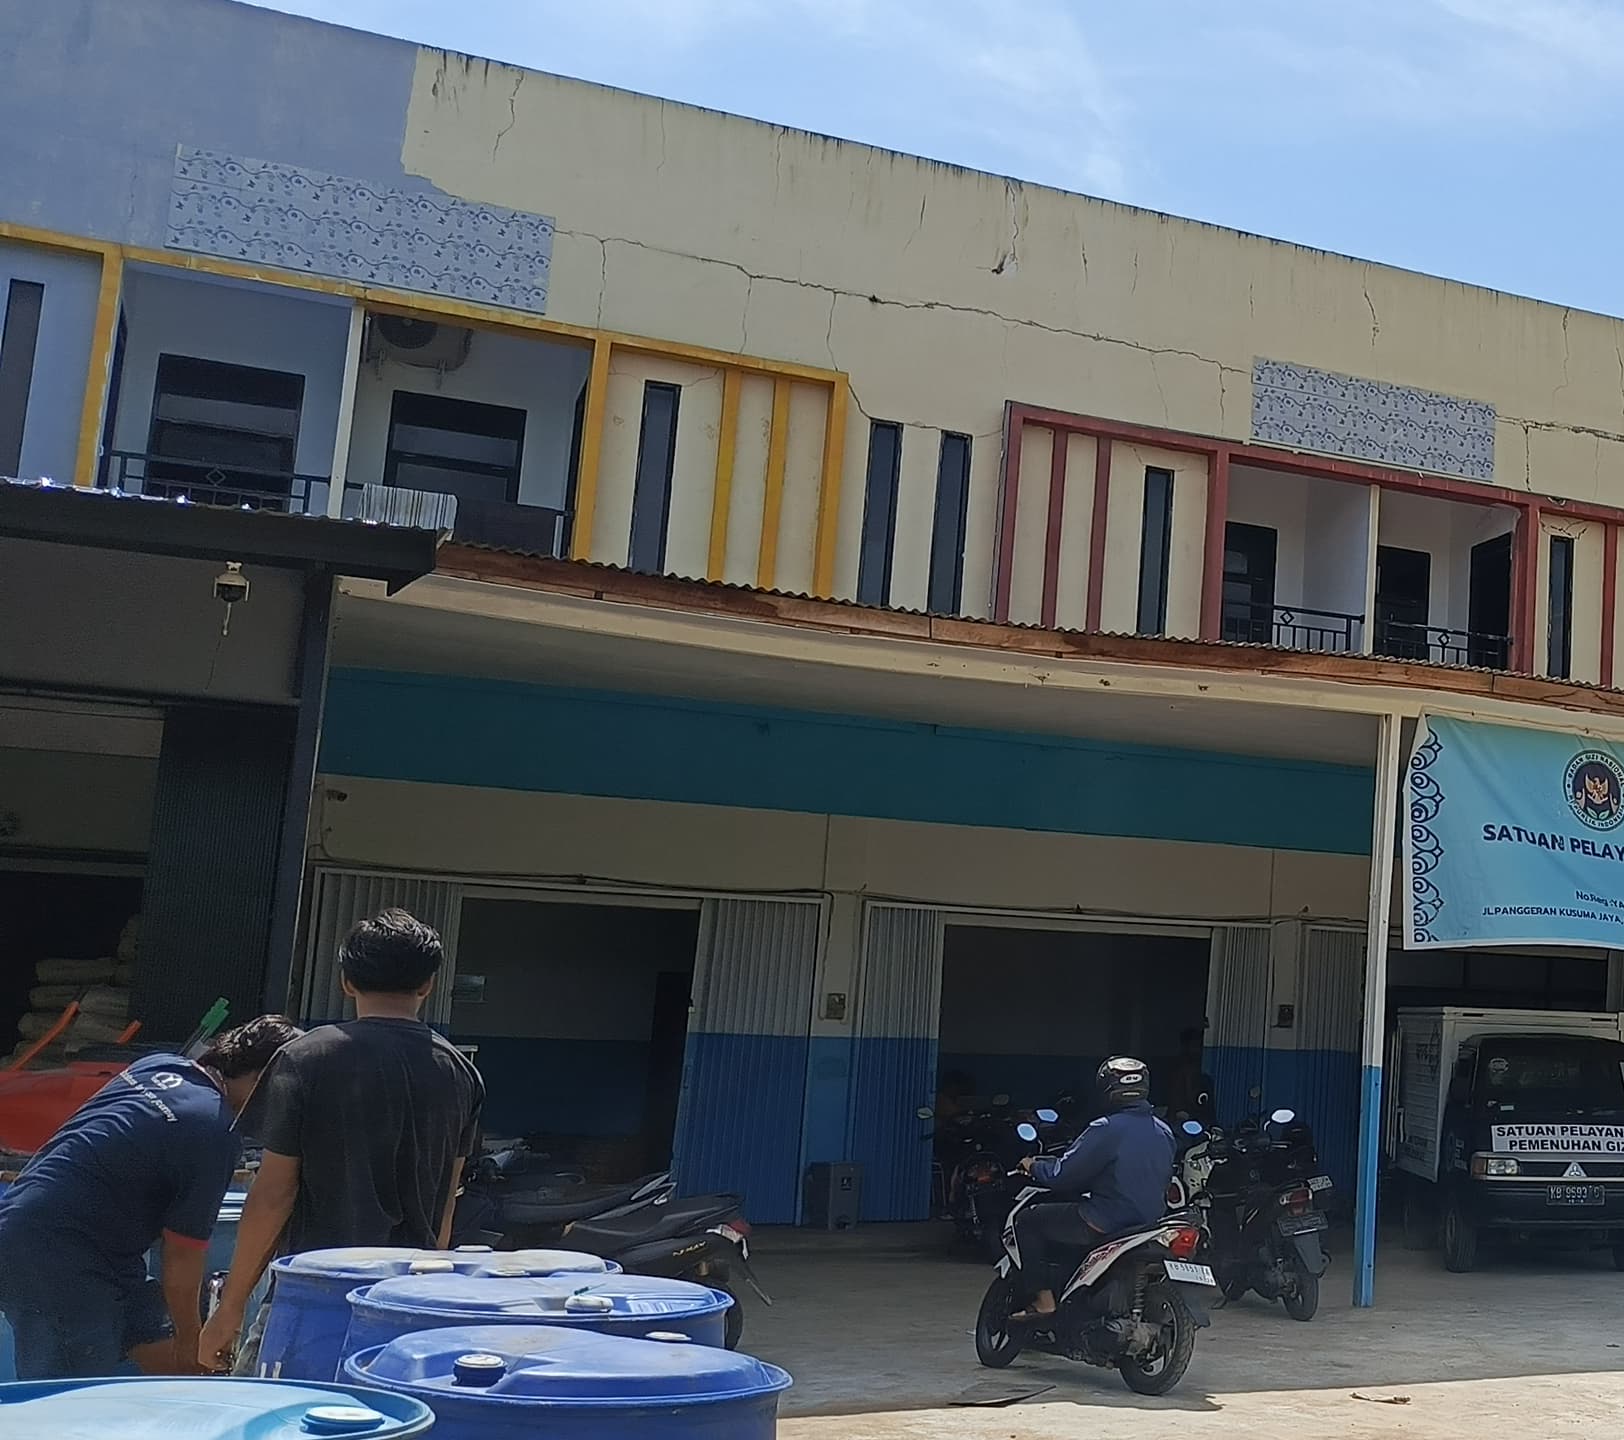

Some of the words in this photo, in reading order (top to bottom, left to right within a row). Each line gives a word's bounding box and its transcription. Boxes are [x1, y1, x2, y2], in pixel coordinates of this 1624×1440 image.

[1482, 824, 1565, 851] SATUAN
[1559, 908, 1597, 920] KUSUMA
[1496, 1125, 1556, 1137] SATUAN
[1509, 1139, 1602, 1151] PEMENUHAN
[1550, 1186, 1562, 1199] KB
